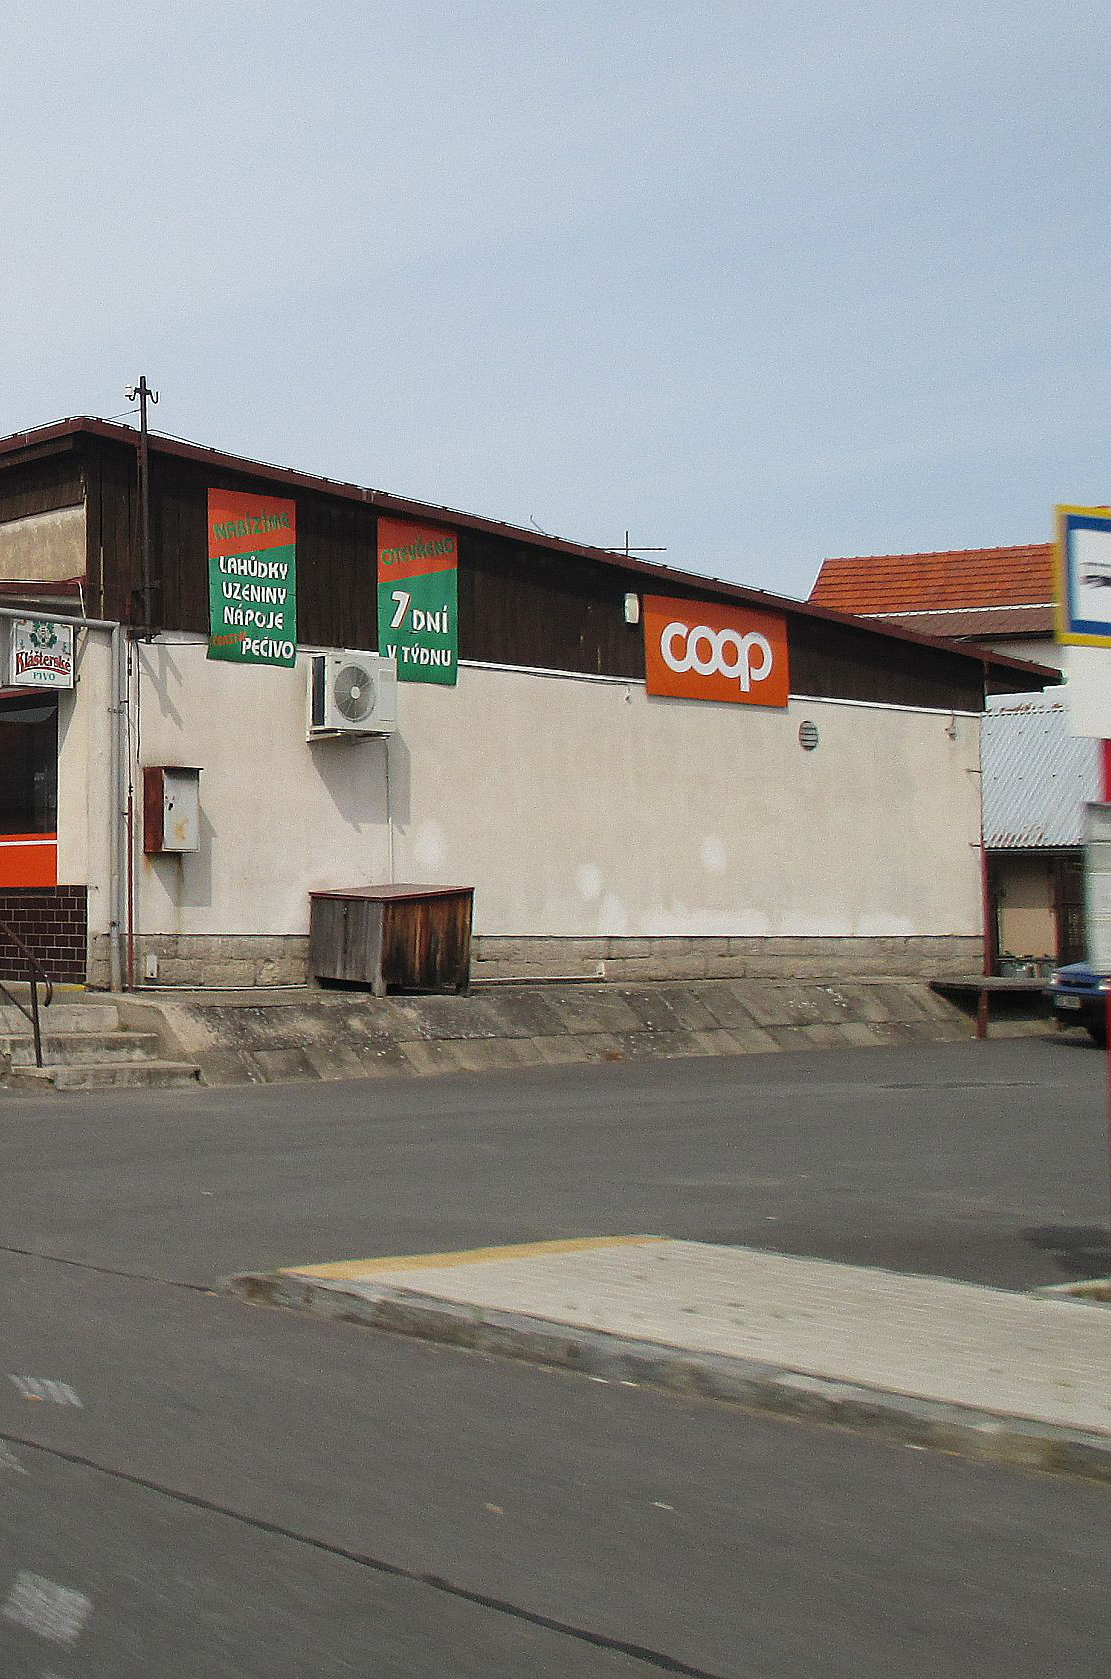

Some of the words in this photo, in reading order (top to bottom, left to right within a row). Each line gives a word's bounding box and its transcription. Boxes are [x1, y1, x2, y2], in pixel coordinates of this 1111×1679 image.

[219, 555, 288, 580] LAHŮDKY
[222, 582, 287, 605] UZENINY
[223, 604, 284, 630] NÁPOJE
[390, 590, 410, 628] 7
[412, 605, 448, 634] DNÍ
[241, 634, 295, 659] PEČIVO
[386, 643, 398, 659] V
[401, 642, 452, 667] TÝDNU
[660, 621, 773, 693] coop
[15, 650, 71, 676] Klášterské
[33, 671, 56, 681] PIVO
